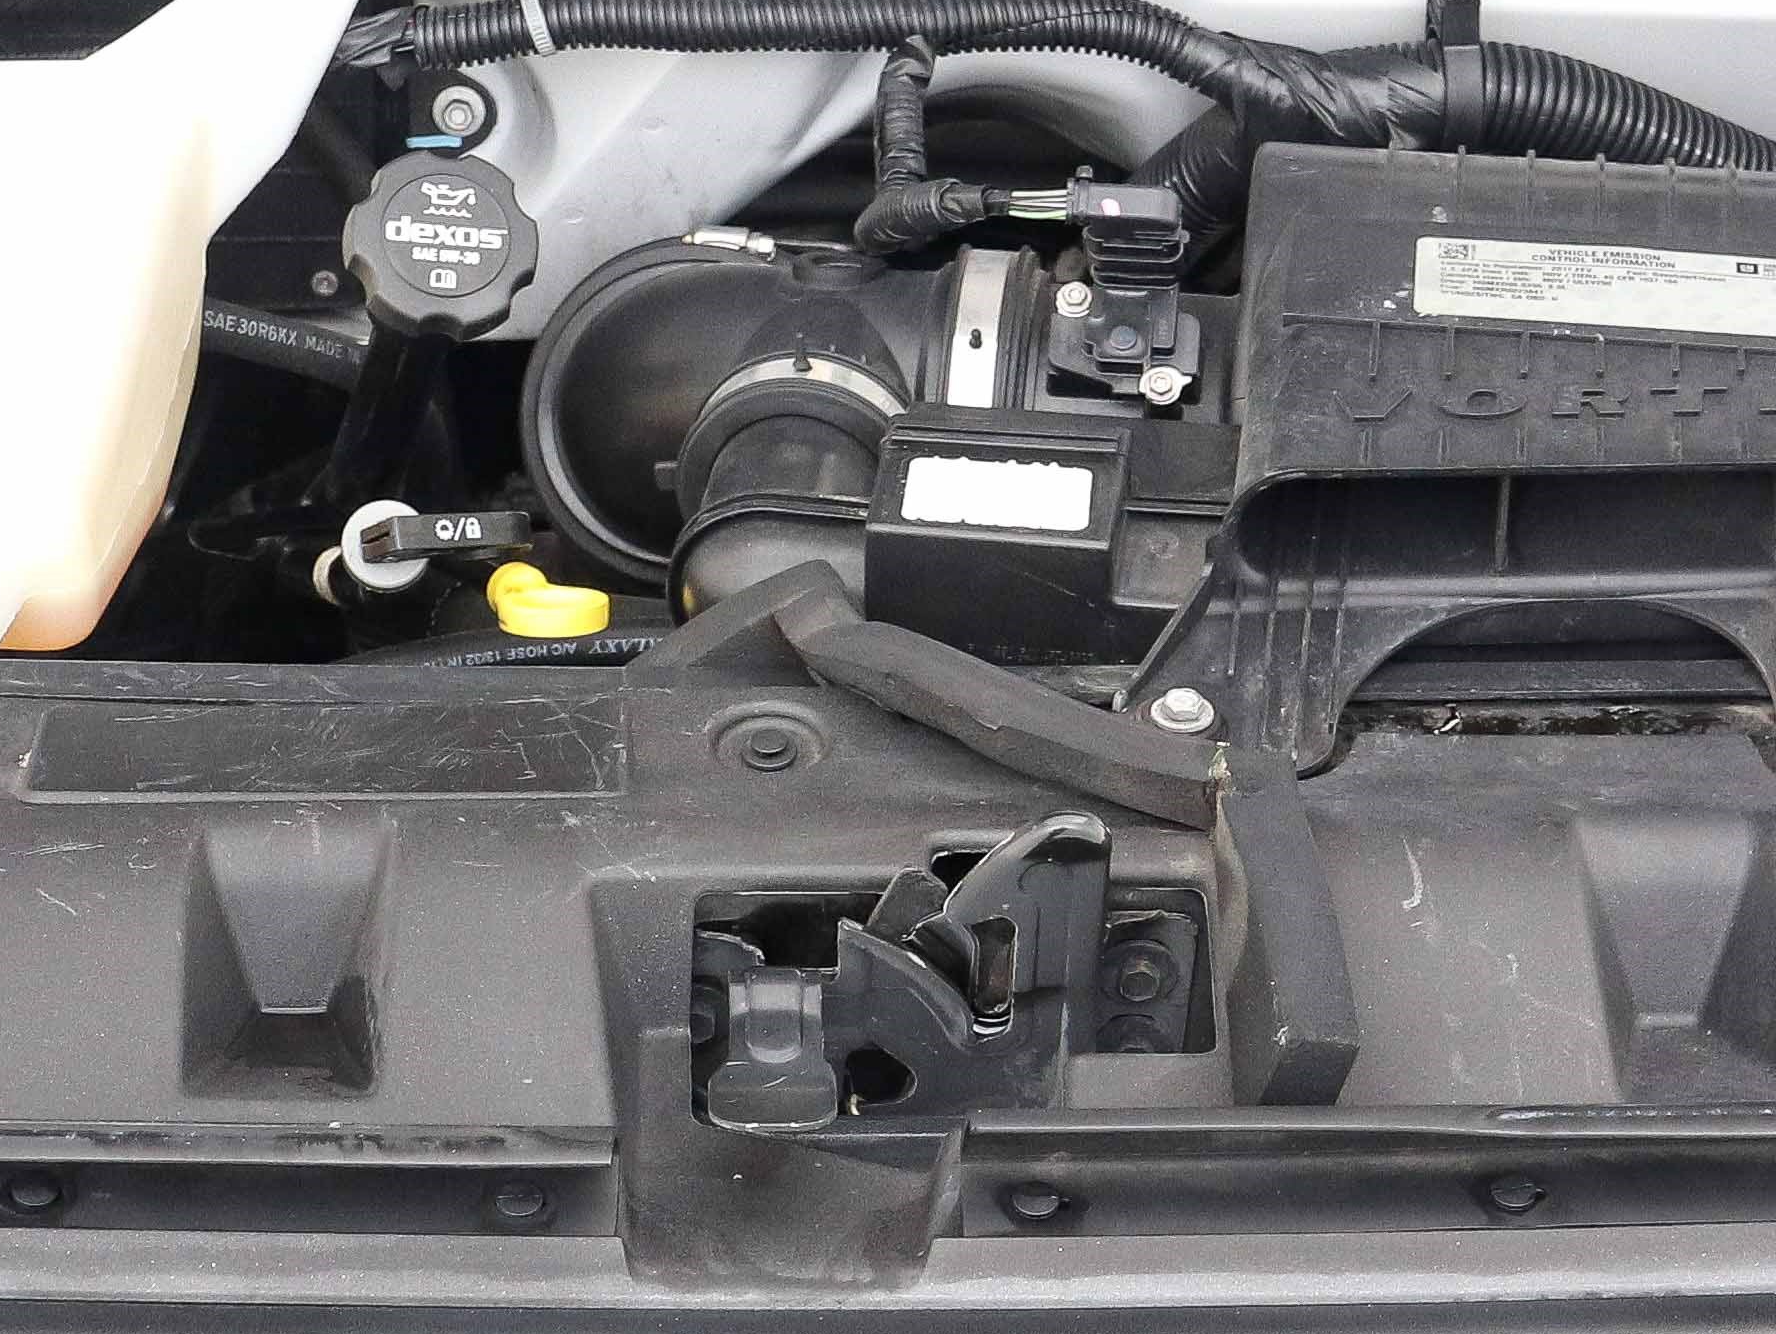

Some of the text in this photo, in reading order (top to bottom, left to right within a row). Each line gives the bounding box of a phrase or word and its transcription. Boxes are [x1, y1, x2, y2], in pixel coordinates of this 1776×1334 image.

[385, 215, 509, 249] dexos
[1531, 254, 1676, 269] CONTROL INFORMATION
[1548, 248, 1661, 262] VEHICLE EMISSION
